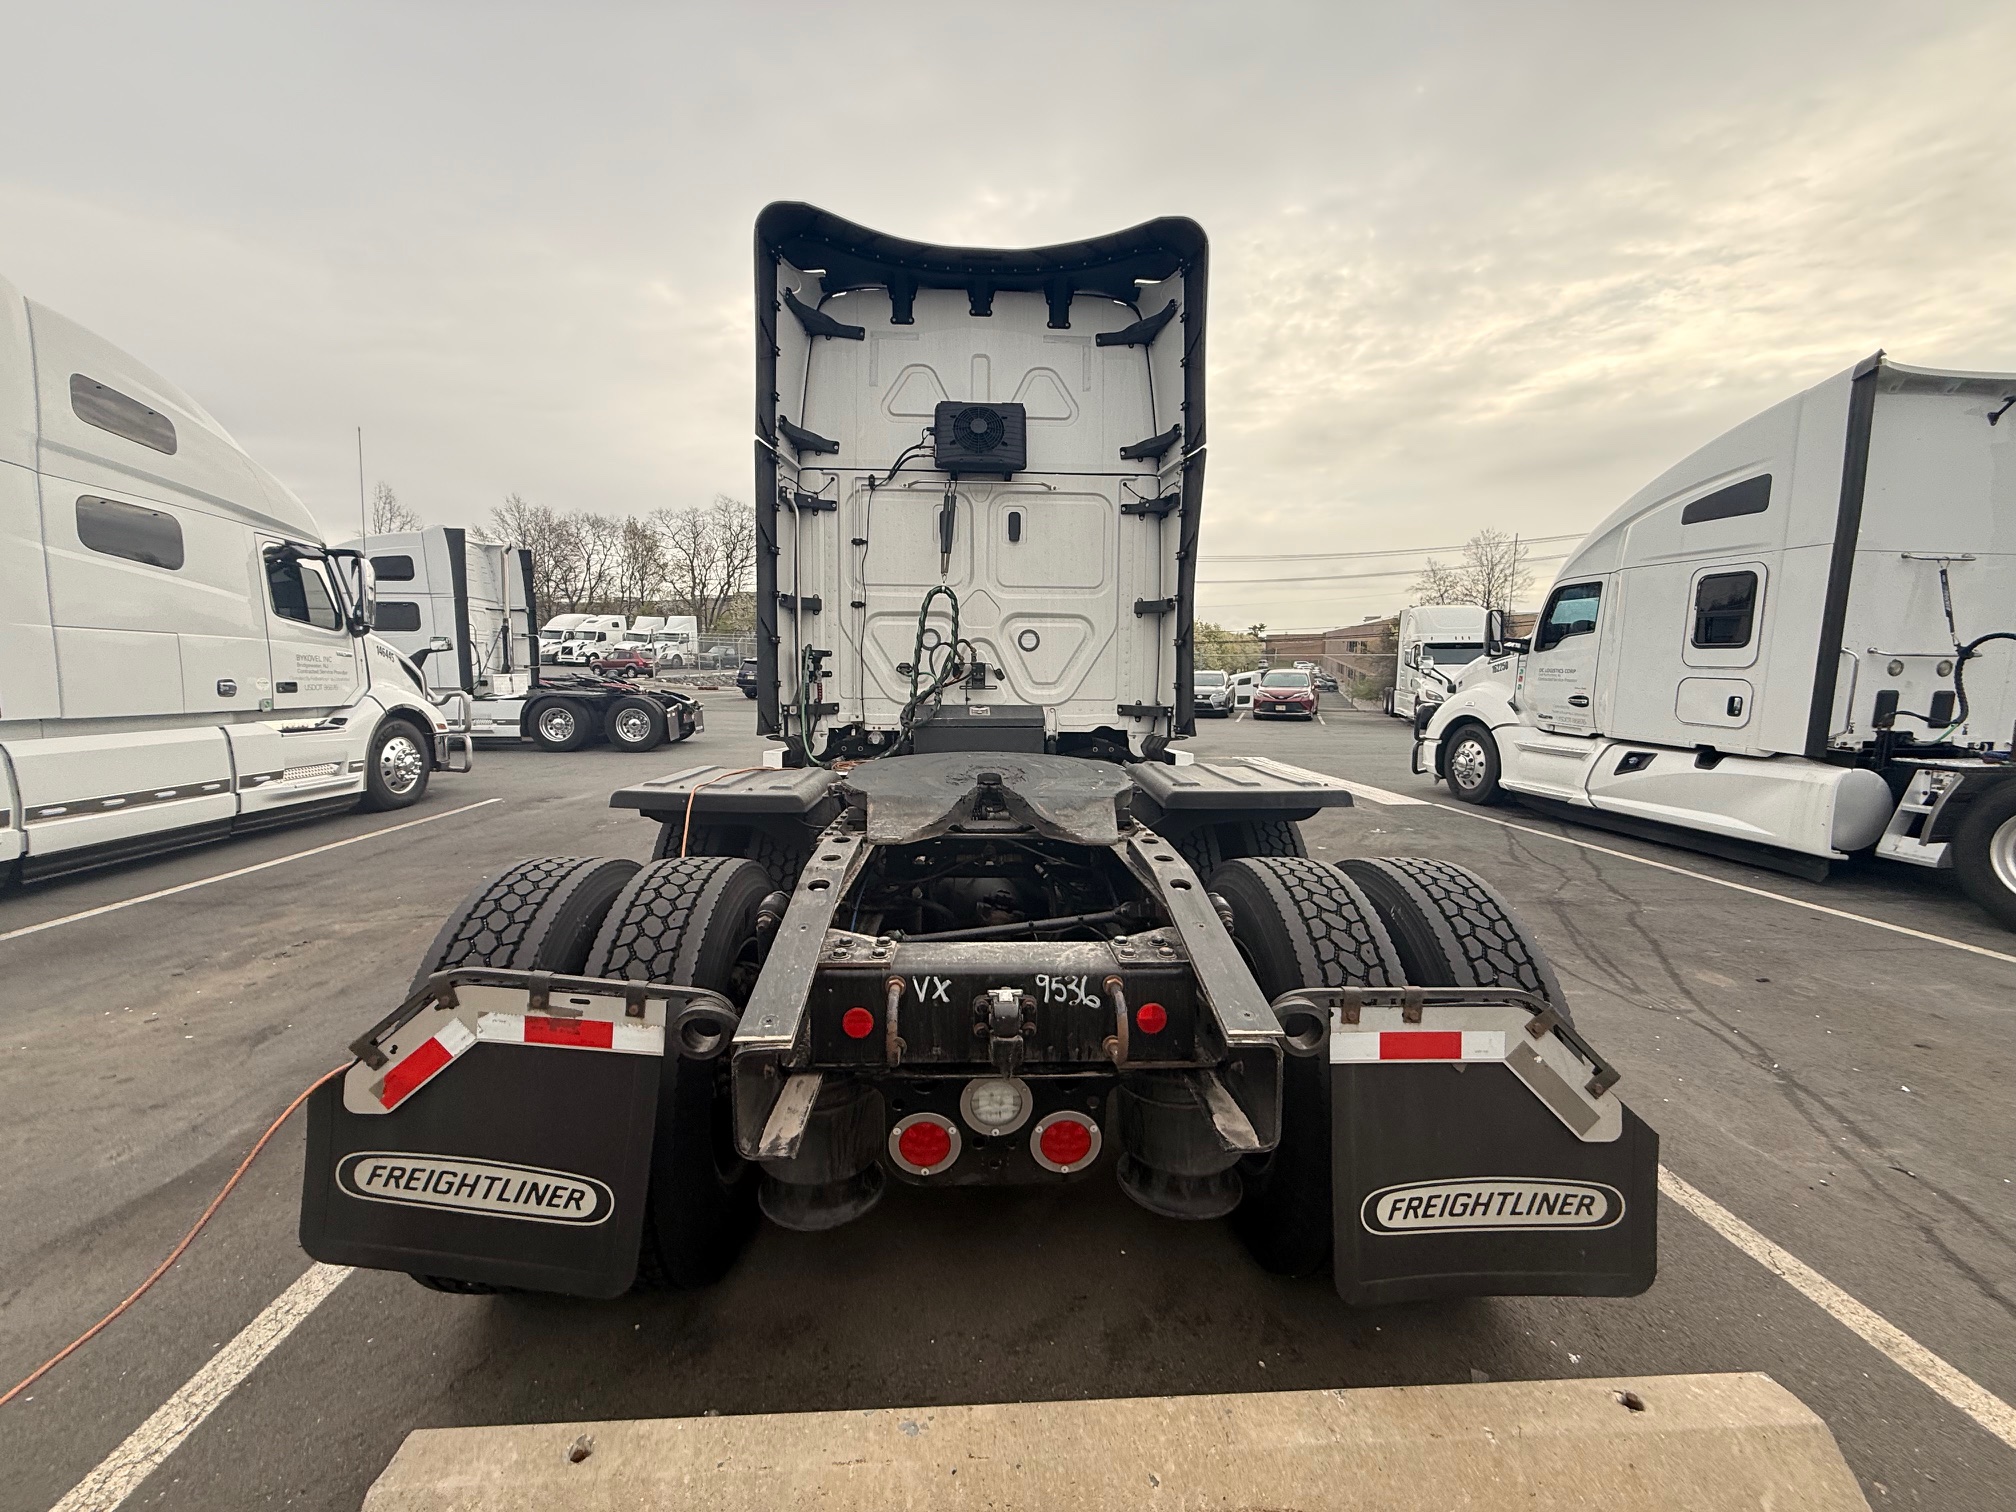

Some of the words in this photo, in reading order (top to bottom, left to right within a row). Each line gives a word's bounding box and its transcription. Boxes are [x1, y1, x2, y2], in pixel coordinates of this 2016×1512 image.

[376, 645, 395, 663] 146445
[912, 975, 952, 1003] VX
[1035, 974, 1101, 1008] 9536
[366, 1165, 586, 1211] FREIGHTLINER
[1388, 1192, 1596, 1221] FREIGHTLINER
